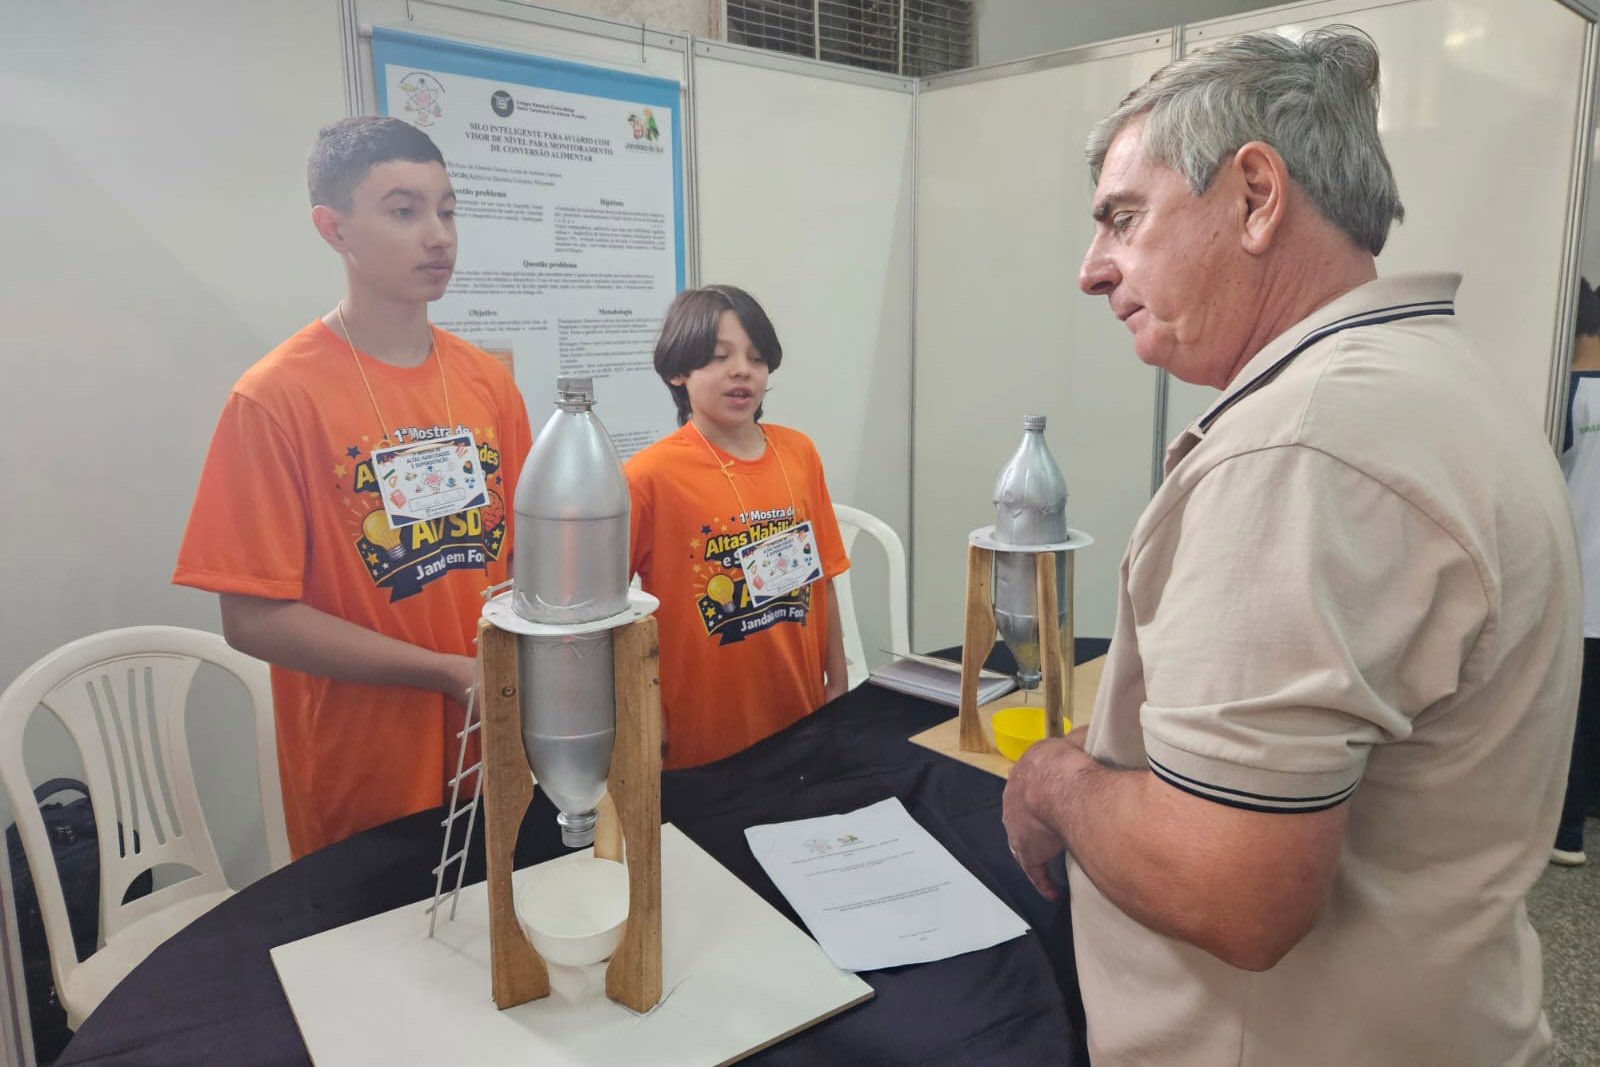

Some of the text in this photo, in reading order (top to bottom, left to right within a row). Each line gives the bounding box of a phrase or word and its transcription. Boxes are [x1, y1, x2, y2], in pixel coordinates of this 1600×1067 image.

[465, 131, 490, 142] VISOR
[492, 134, 502, 143] DE
[529, 138, 549, 149] PARA
[550, 140, 613, 156] MONITORAMENTO
[470, 122, 488, 132] SILO
[490, 125, 541, 139] INTELIGENTE
[543, 131, 563, 141] PARA
[594, 137, 610, 146] COM
[490, 144, 593, 163] DE CONVERSÃO ALIMENTAR
[475, 189, 507, 198] problema
[409, 426, 452, 441] Mostra
[750, 509, 786, 521] Mostra
[706, 535, 748, 558] Altas
[416, 555, 447, 581] Jand
[446, 552, 466, 564] em
